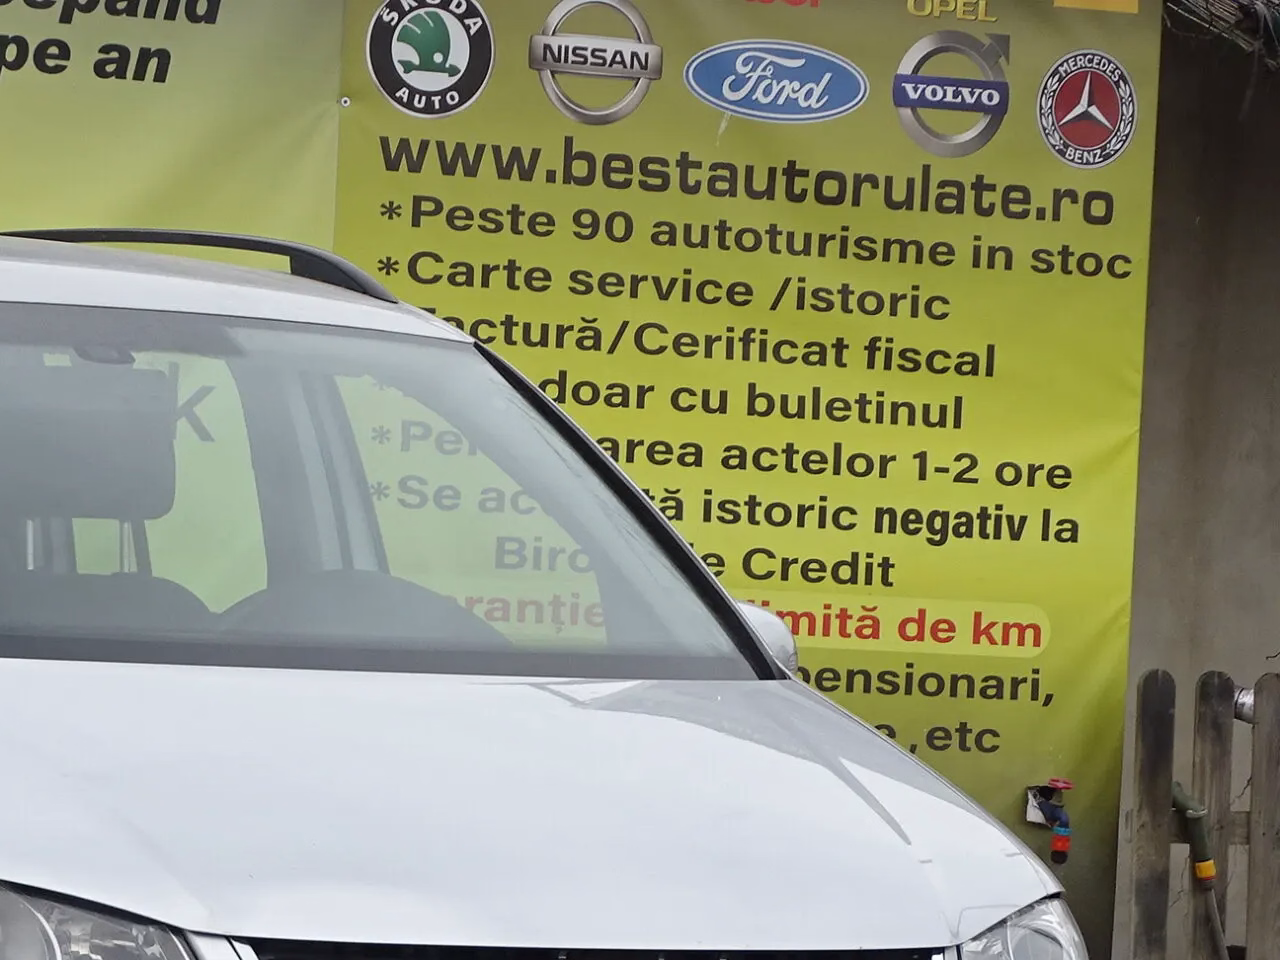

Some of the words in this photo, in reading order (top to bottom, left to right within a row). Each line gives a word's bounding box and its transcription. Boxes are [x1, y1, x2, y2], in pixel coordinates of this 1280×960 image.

[92, 42, 172, 84] an
[542, 42, 650, 72] NISSAN
[1057, 54, 1122, 82] MERCEDES
[394, 86, 461, 111] AUTO
[733, 46, 835, 114] Ford
[901, 80, 1002, 110] VOLVO
[1064, 146, 1104, 164] BENZ
[378, 135, 1115, 227] www.bestautorulate.ro
[571, 210, 635, 245] 90
[650, 218, 957, 269] autoturisme
[971, 226, 1014, 272] in
[1029, 234, 1134, 282] stoc
[567, 266, 755, 310] service
[768, 274, 952, 322] /istoric
[862, 336, 997, 379] fiscal
[536, 369, 654, 413] doar
[669, 379, 730, 416] cu
[746, 382, 965, 431] buletinul
[721, 438, 898, 482] actelor
[912, 451, 980, 486] 1-2
[993, 461, 1074, 491] ore
[701, 497, 858, 534] istoric
[873, 505, 1028, 547] negativ
[1042, 509, 1082, 545] la
[742, 547, 896, 590] Credit
[897, 608, 957, 645] de
[971, 611, 1042, 648] km
